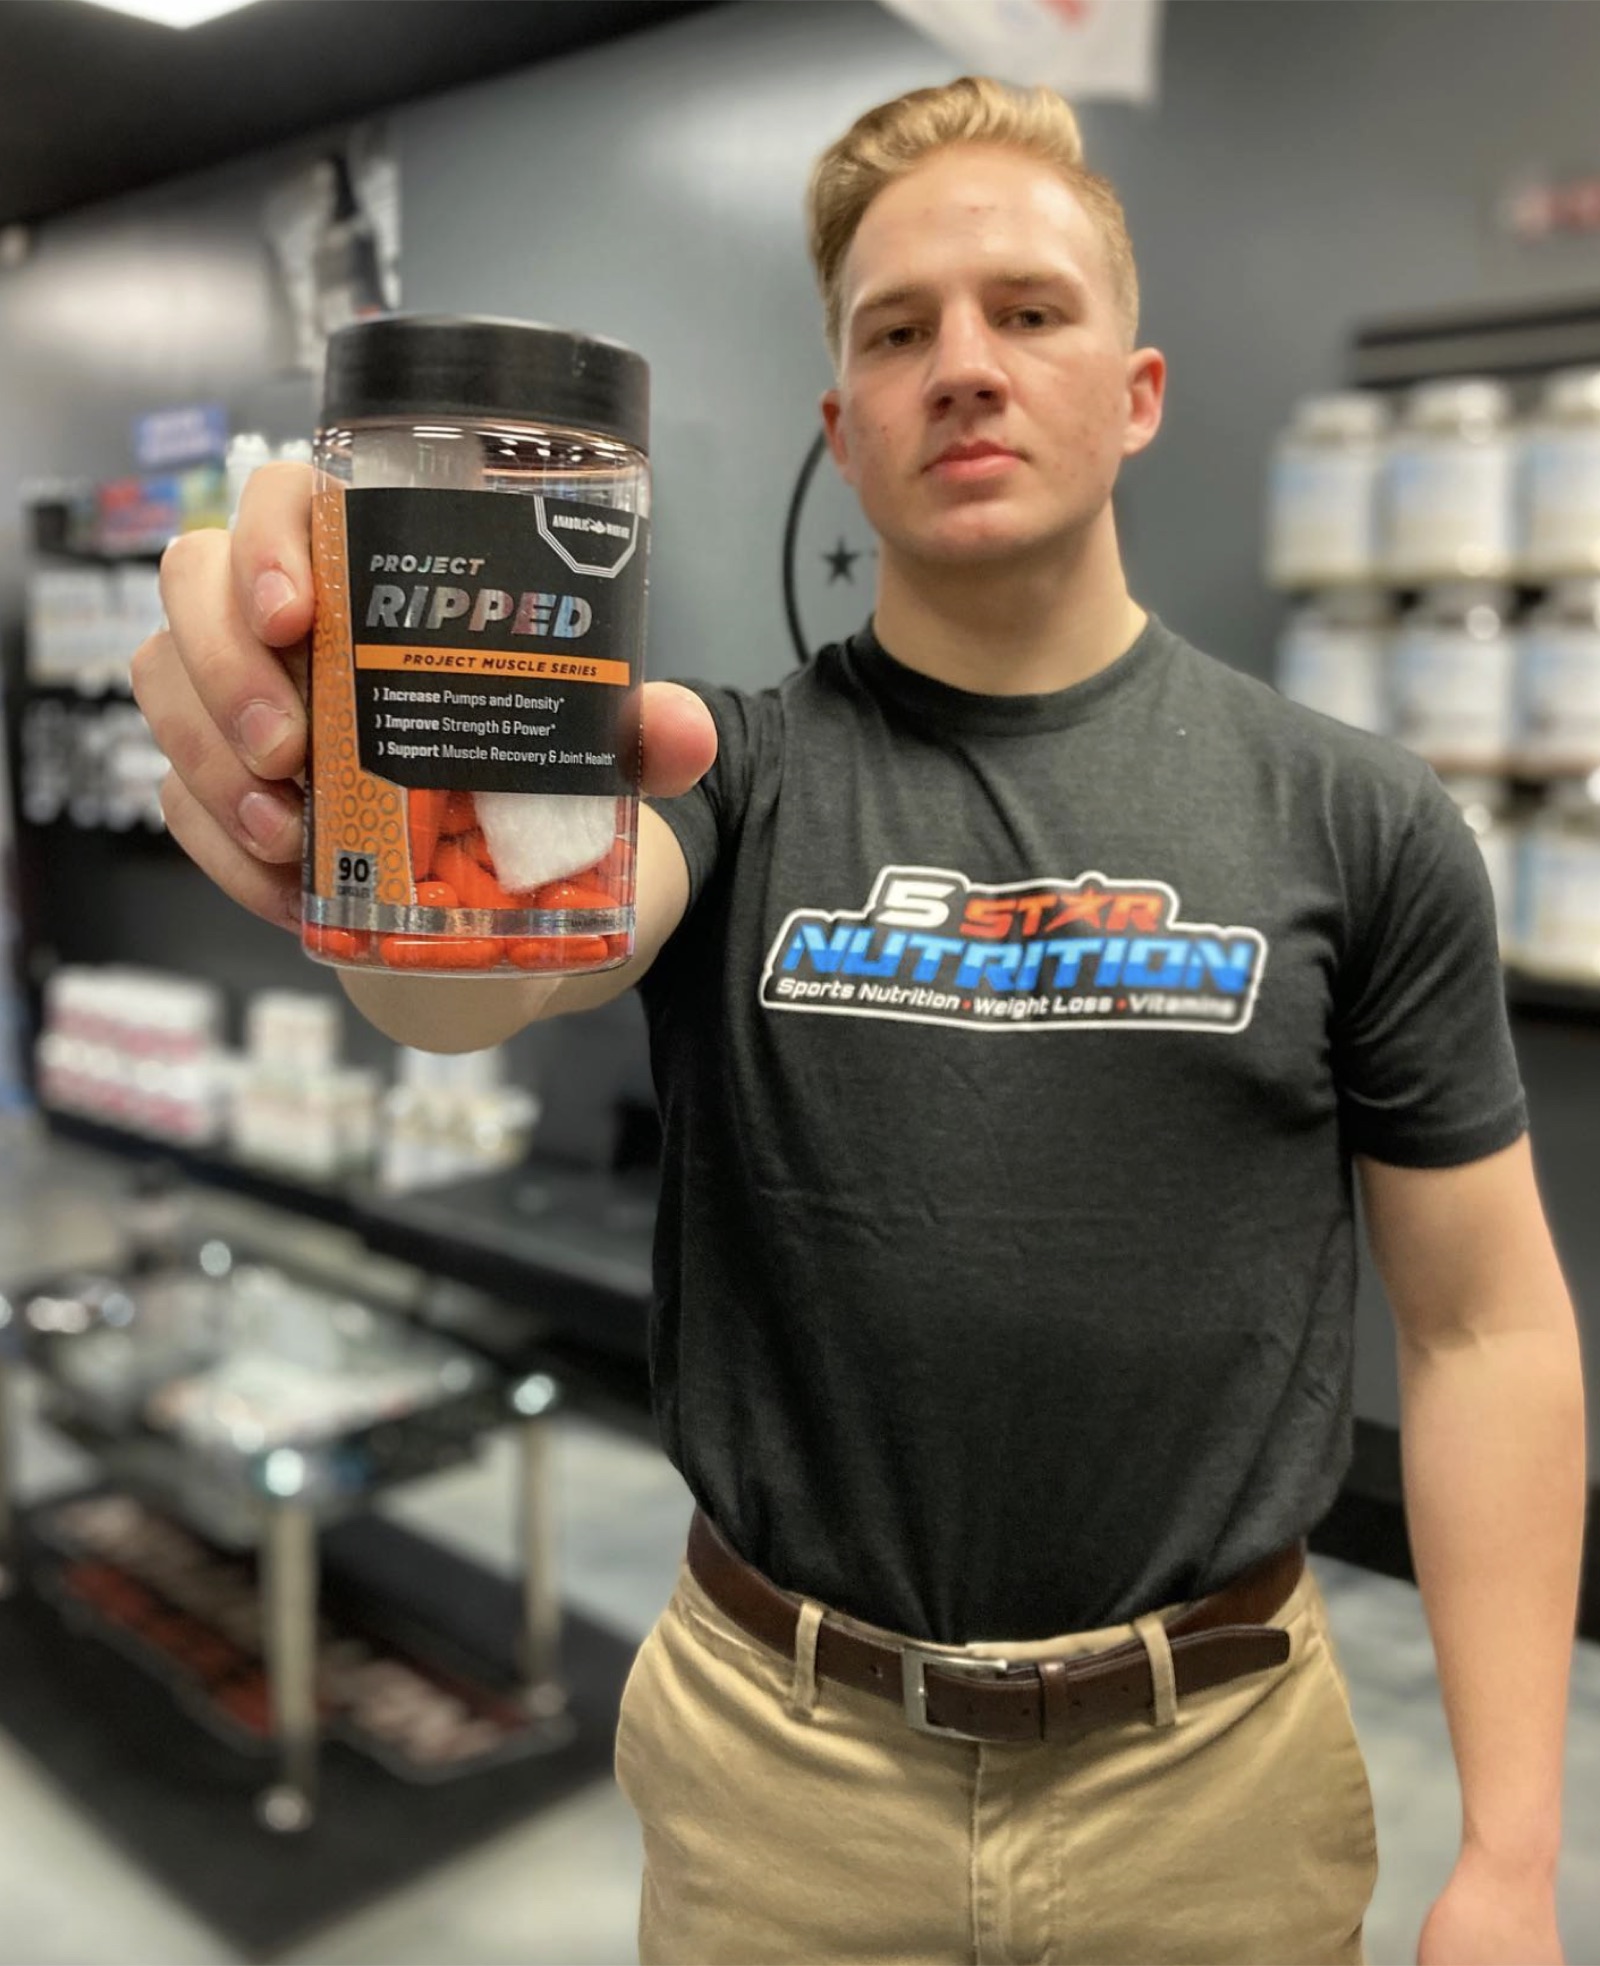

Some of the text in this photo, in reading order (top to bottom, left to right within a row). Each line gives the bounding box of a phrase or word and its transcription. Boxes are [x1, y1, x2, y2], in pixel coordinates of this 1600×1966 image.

[370, 554, 486, 576] PROJECT
[365, 584, 593, 639] RIPPED
[402, 653, 598, 677] PROJECT MUSCLE SERIES
[383, 687, 441, 703] Increase
[443, 690, 487, 708] Pumps
[489, 693, 513, 708] and
[385, 714, 440, 732] Improve
[442, 717, 499, 736] Strength
[502, 720, 512, 735] &
[387, 741, 440, 759] Support
[442, 744, 488, 760] Muscle
[490, 746, 547, 765] Recovery
[548, 749, 557, 763] &
[558, 750, 584, 765] Joint
[338, 856, 370, 883] 90
[876, 879, 956, 928] 5
[781, 923, 1253, 993] NUTRITION
[776, 977, 1236, 1020] Sports Nutrition Weight Loss Vitas
